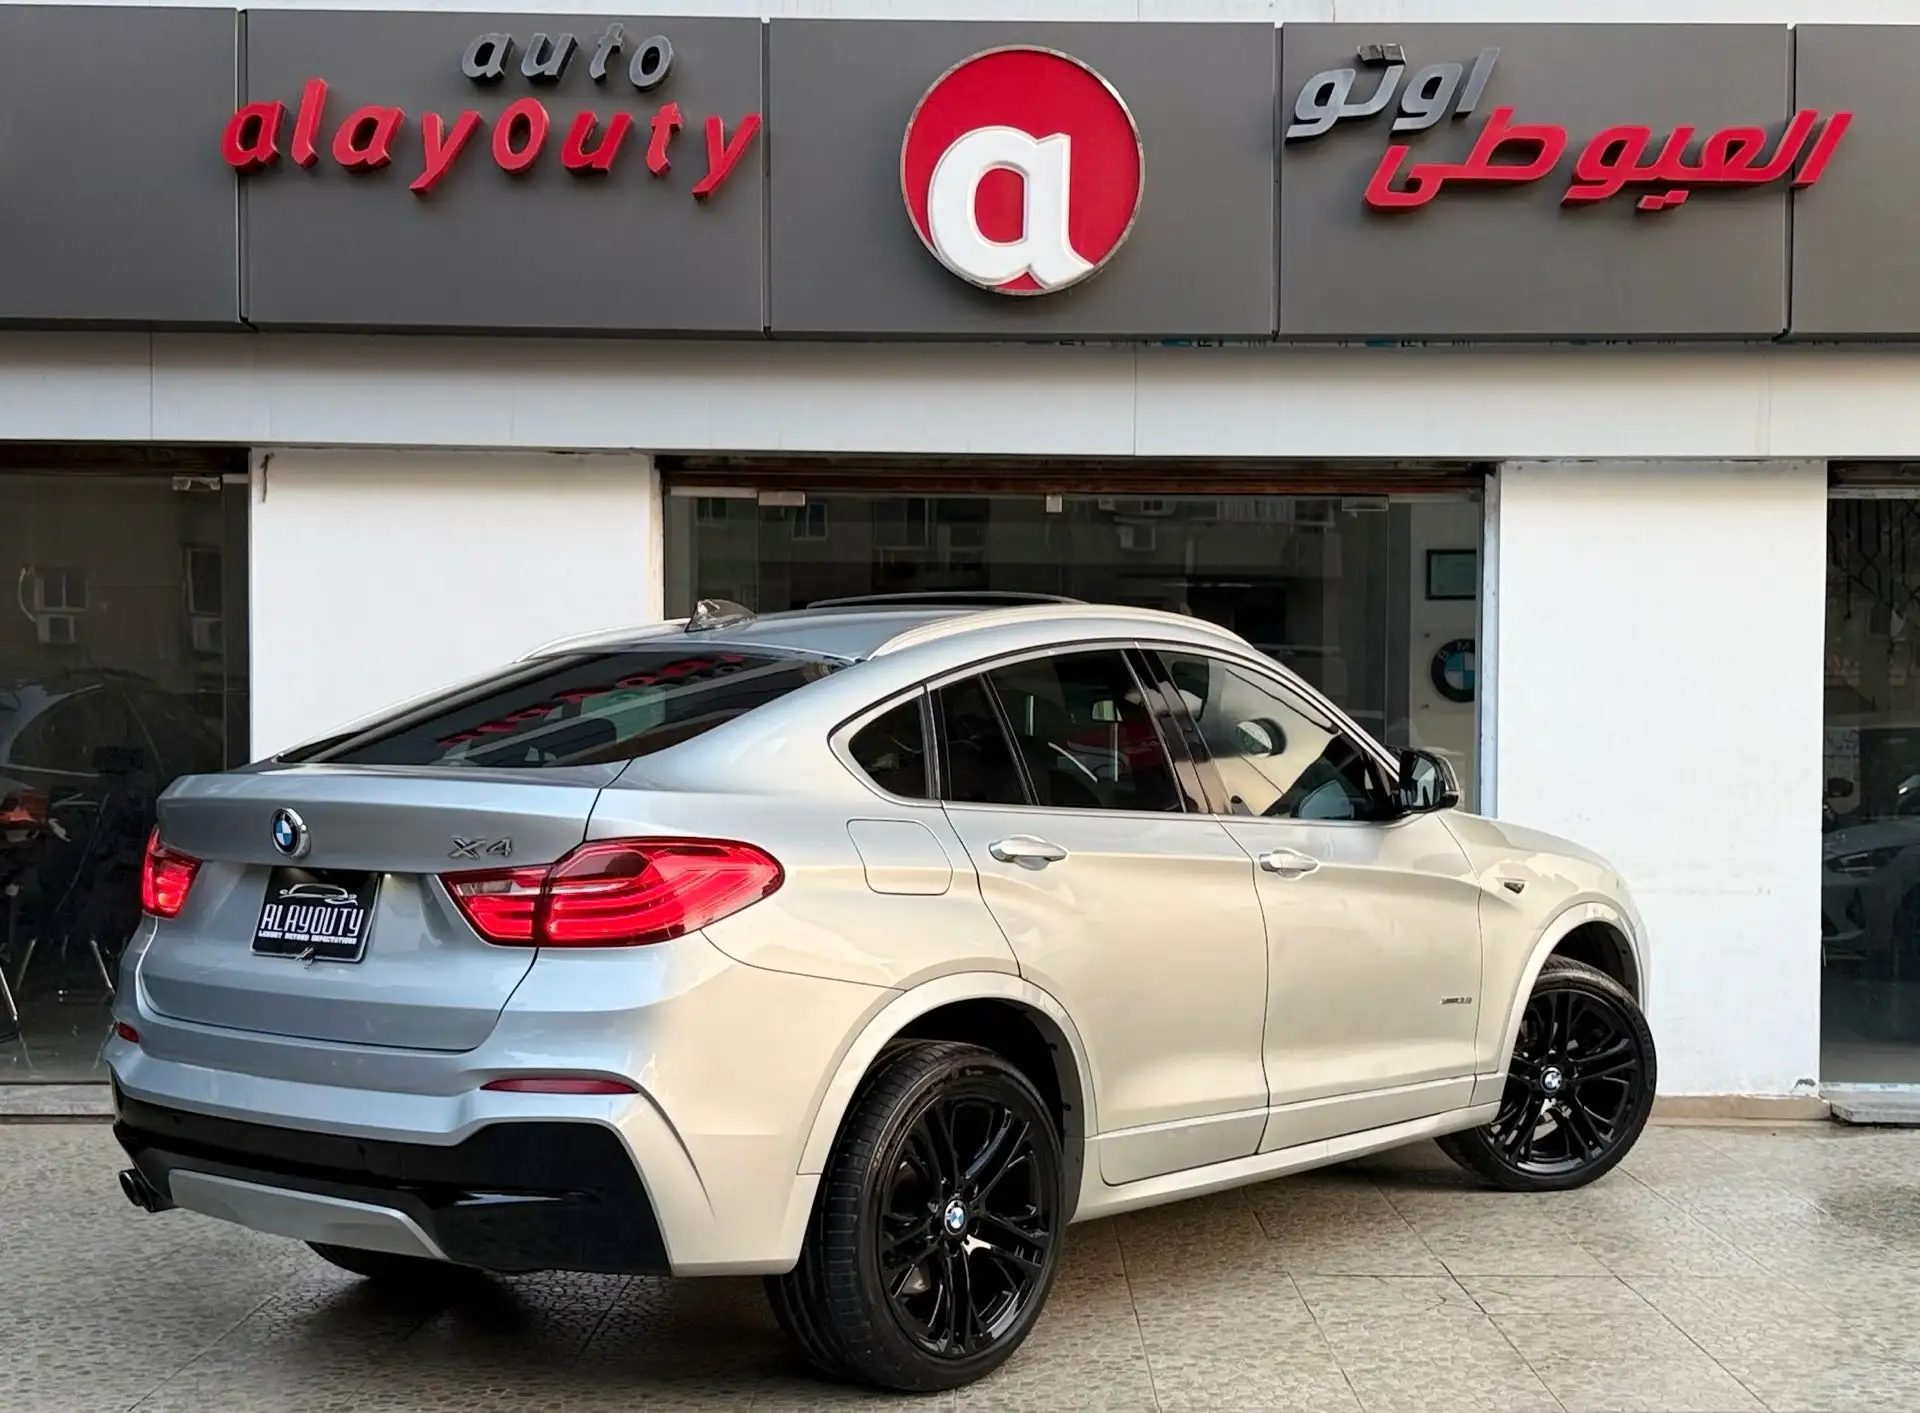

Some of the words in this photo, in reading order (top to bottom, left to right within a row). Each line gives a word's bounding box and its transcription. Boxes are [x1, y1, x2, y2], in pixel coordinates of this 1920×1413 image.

[461, 22, 676, 92] auto
[1285, 43, 1500, 143] اوتو
[221, 77, 762, 199] alayouty
[927, 125, 1094, 290] a
[448, 836, 512, 860] X4
[260, 903, 364, 937] ALAYOUTY
